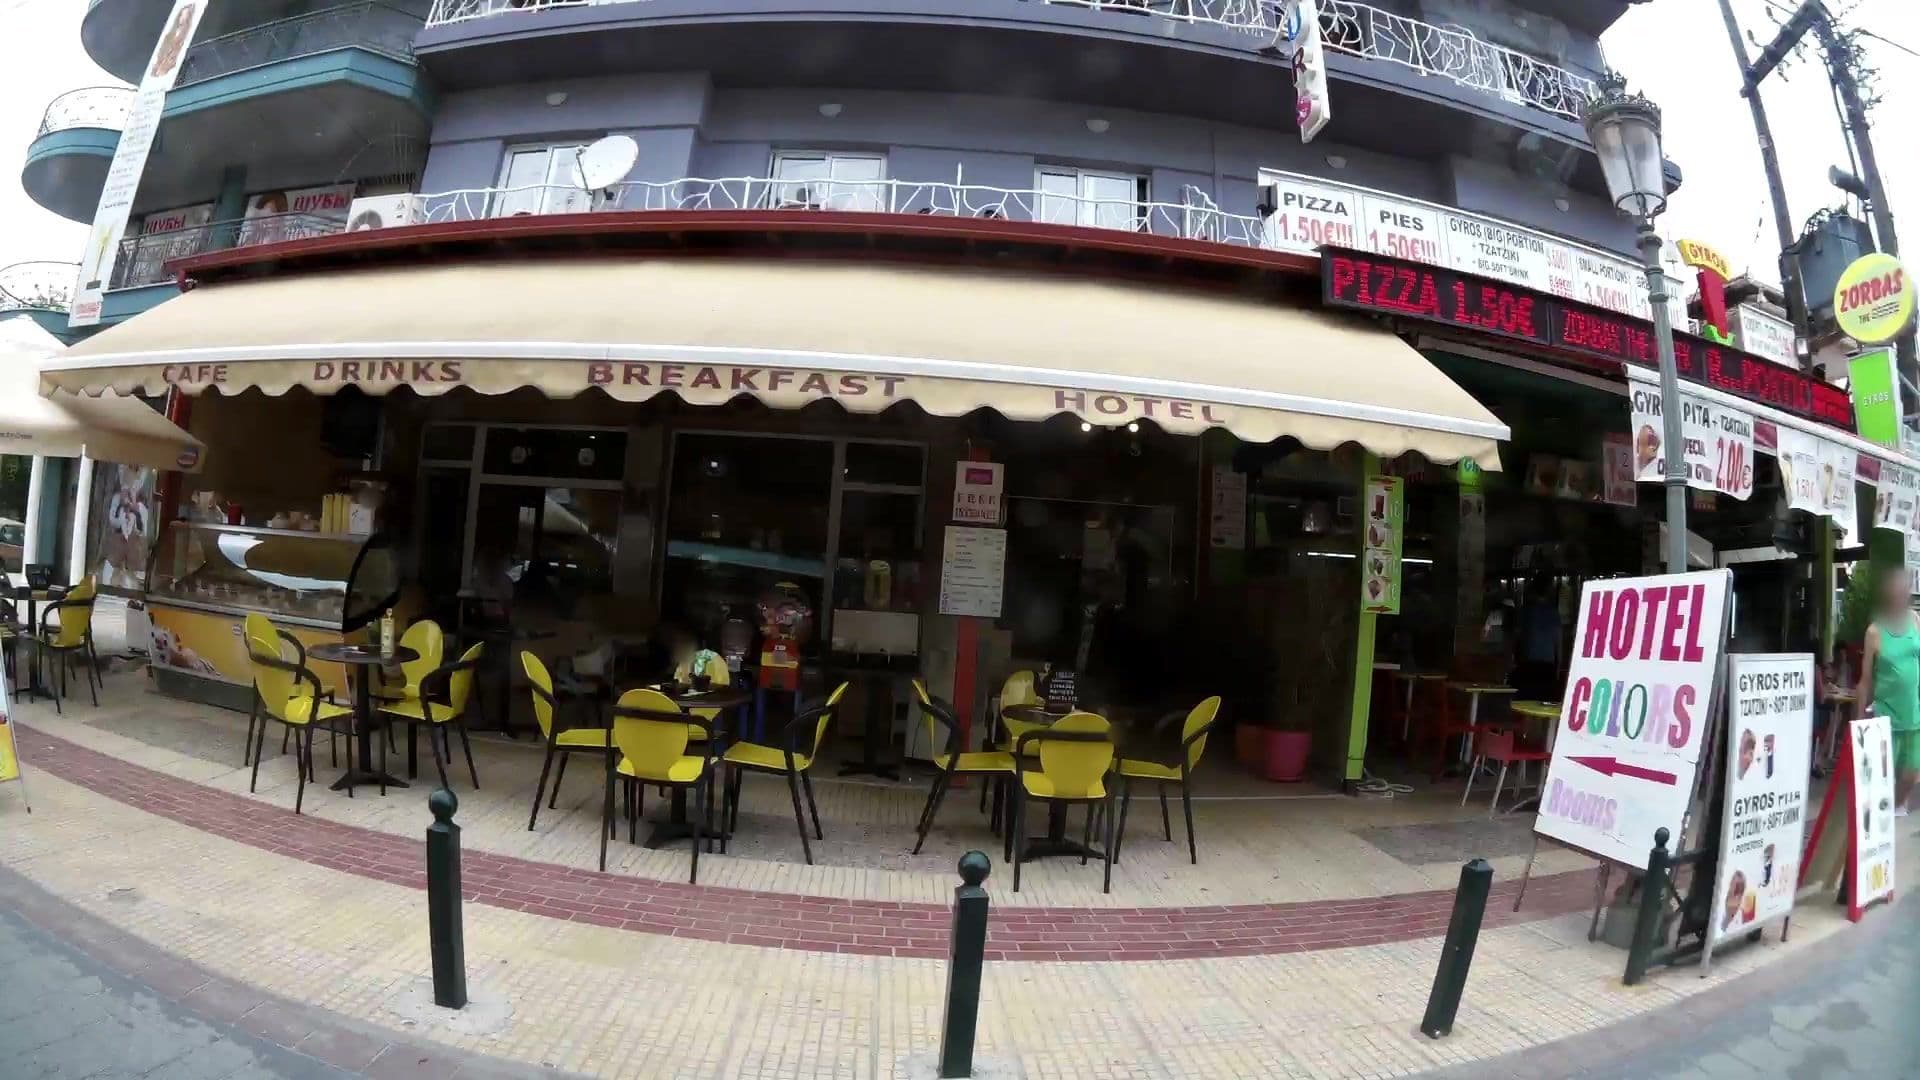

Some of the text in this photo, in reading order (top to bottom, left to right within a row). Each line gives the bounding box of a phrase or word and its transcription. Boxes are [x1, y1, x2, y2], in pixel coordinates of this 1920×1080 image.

[293, 192, 348, 212] ШУБЫ
[1283, 192, 1349, 217] PIZZA
[1379, 210, 1425, 232] PIES
[1449, 217, 1482, 238] GYROS
[1506, 232, 1545, 254] PORTION
[1480, 243, 1520, 262] TZATZIKI
[1333, 258, 1441, 320] PIZZA
[1452, 281, 1536, 337] 1.50€
[1840, 268, 1904, 313] ZORBAS
[162, 361, 1226, 424] CAFE DRINKS BREAKFAST HOTEL
[1634, 391, 1663, 416] GYR
[1683, 402, 1710, 428] PITA
[1582, 584, 1705, 662] HOTEL
[1739, 671, 1805, 692] GYROS PITA
[1567, 676, 1696, 749] COLORS
[1733, 791, 1775, 817] GYROS
